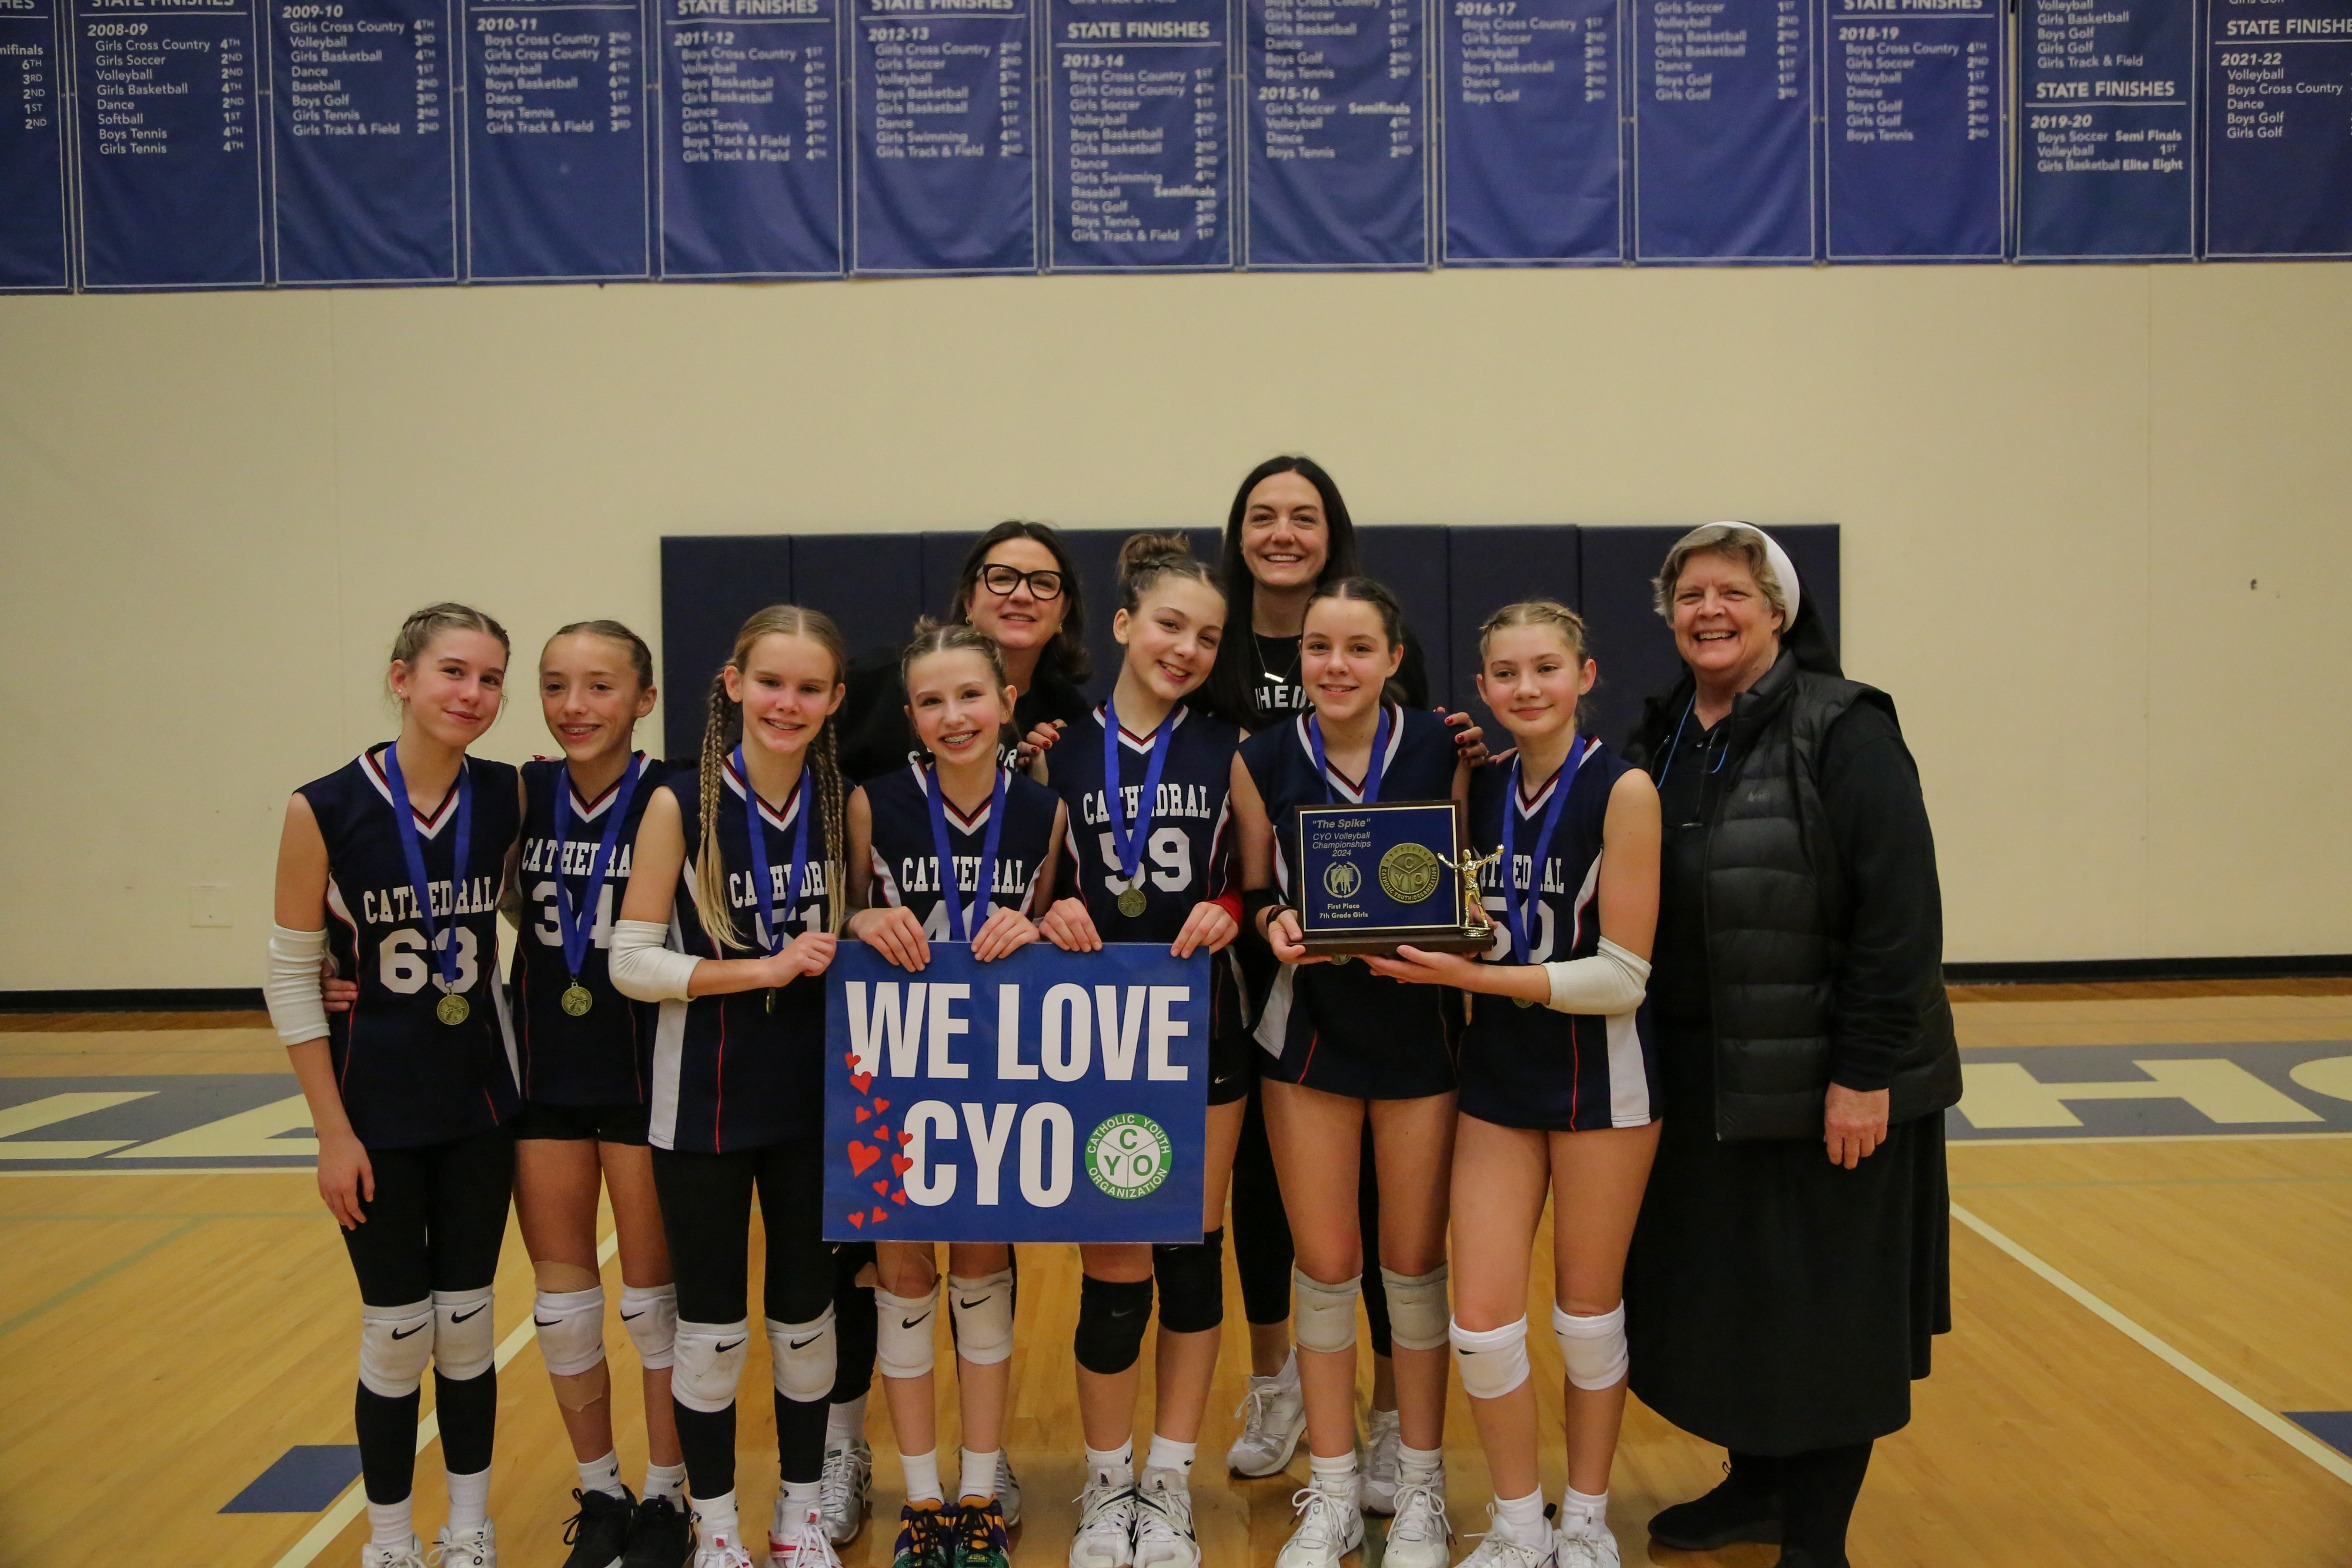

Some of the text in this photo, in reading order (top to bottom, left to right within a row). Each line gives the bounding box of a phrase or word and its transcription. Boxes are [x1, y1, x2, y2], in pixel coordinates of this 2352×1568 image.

[282, 5, 343, 18] 2009-10
[678, 0, 818, 15] STATE FINISHES
[872, 0, 1013, 10] STATE FINISHES
[1455, 2, 1516, 16] 2016-17
[1845, 0, 1982, 10] STATE FINISHES
[88, 24, 148, 36] 2008-09
[290, 20, 434, 34] Girls Cross Country 4TH
[477, 18, 537, 31] 2010-11
[1068, 22, 1210, 39] STATE FINISHES
[2227, 20, 2279, 35] STATE
[674, 31, 734, 46] 2011-12
[868, 26, 929, 41] 2012-13
[1839, 27, 1899, 41] 2018-19
[96, 39, 240, 52] Girls Cross Country 4TH
[290, 36, 347, 51] Volleyball
[876, 44, 903, 56] Girls
[906, 44, 940, 55] Cross
[942, 42, 990, 58] Country
[1846, 43, 1874, 59] Boys
[1877, 42, 1910, 54] Cross
[1913, 42, 1959, 56] Country
[96, 53, 242, 66] Girls Soccer 2ND
[681, 49, 709, 63] Boys
[711, 46, 746, 60] Cross
[749, 48, 796, 62] Country
[1063, 54, 1123, 68] 2013-14
[2037, 55, 2143, 68] Girls Track & Field
[2221, 53, 2281, 65] 2021-22
[22, 59, 41, 69] 6TH
[96, 68, 243, 83] Volleyball 2ND
[292, 66, 328, 77] Dance
[2228, 68, 2284, 82] Volleyball
[23, 74, 42, 84] 3RD
[24, 89, 45, 99] 2ND
[97, 83, 241, 95] Girls Basketball 4TH
[1258, 87, 1319, 100] 2015-16
[1685, 88, 1710, 101] Golf
[2037, 81, 2174, 98] STATE FINISHES
[2228, 82, 2343, 97] Boys Cross Country
[98, 98, 244, 109] Dance 2ND
[292, 95, 320, 110] Boys
[324, 94, 349, 106] Golf
[486, 92, 523, 104] Dance
[2227, 98, 2264, 109] Dance
[25, 103, 42, 114] 1ST
[25, 119, 46, 129] 2ND
[98, 112, 240, 124] Softball 1ST
[2031, 114, 2092, 128] 2019-20
[2227, 111, 2284, 126] Boys Golf
[99, 126, 242, 142] Boys Tennis 4TH
[293, 125, 320, 136] Girls
[324, 124, 354, 135] Track
[358, 123, 366, 135] &
[371, 123, 400, 134] Field
[2227, 126, 2283, 138] Girls Golf
[2038, 130, 2181, 146] Boys Soccer Semi Finals
[100, 141, 243, 154] Girls Tennis 4TH
[2037, 143, 2094, 160] Volleyball
[1071, 158, 1108, 169] Dance
[1071, 200, 1099, 213] Girls
[1102, 200, 1128, 213] Golf
[1312, 818, 1371, 830] "The Spike"
[1313, 831, 1370, 841] CYO Volleyball
[1312, 841, 1371, 849] Championships
[1098, 827, 1192, 896] 59
[1381, 867, 1437, 900] CATHOLIC YOUTH ORGANIZATION
[532, 881, 616, 949] 34
[379, 926, 478, 994] 63
[845, 981, 1190, 1082] WE LOVE
[1087, 1115, 1170, 1154] CATHOLIC YOUTH
[903, 1099, 1074, 1208] CYO
[1089, 1167, 1168, 1198] ORGANIZATION
